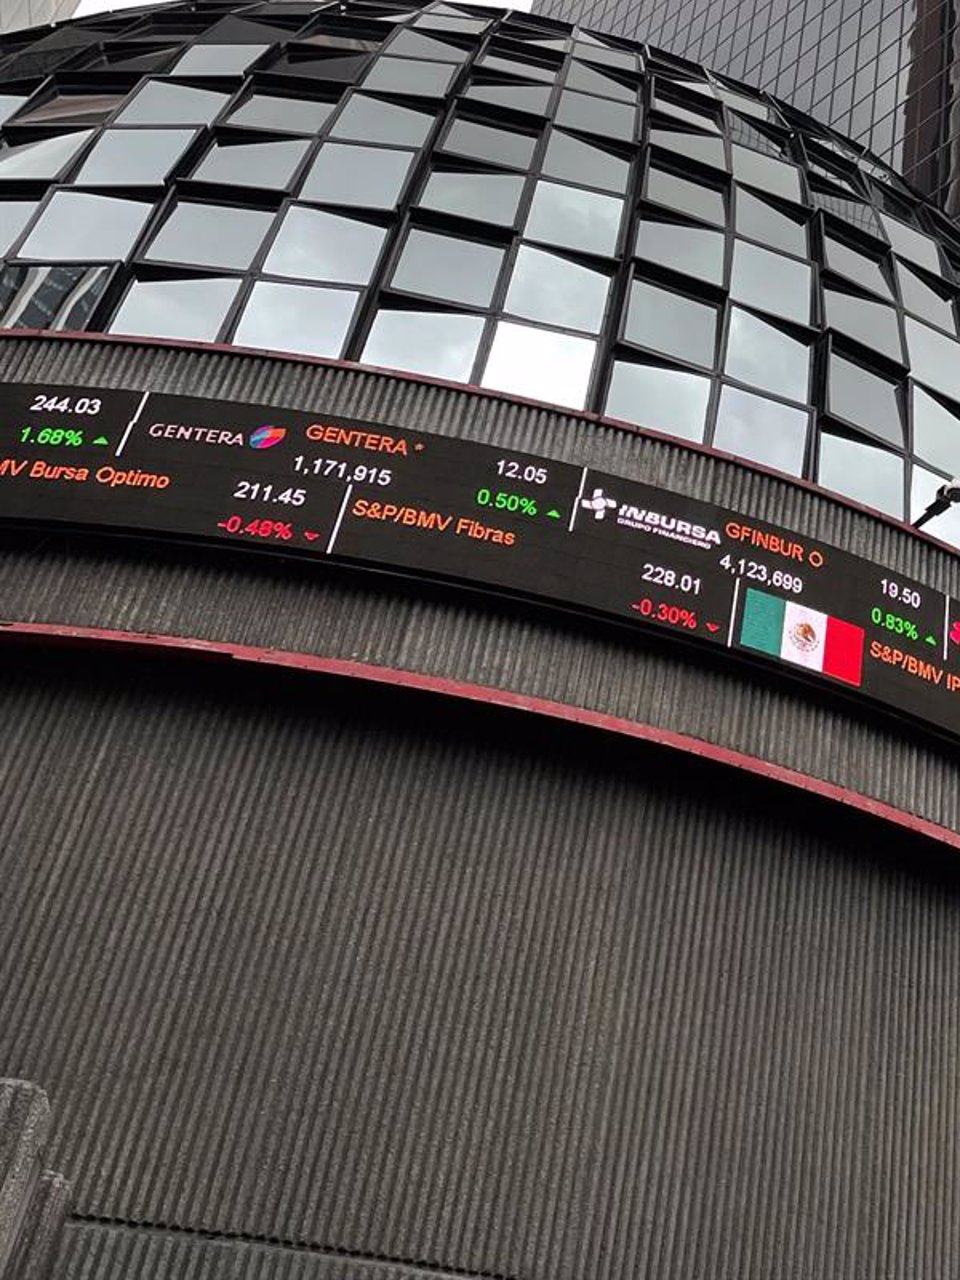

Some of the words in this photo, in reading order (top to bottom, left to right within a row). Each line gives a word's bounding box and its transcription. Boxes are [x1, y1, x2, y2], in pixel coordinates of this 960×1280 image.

[29, 394, 102, 415] 244.03
[19, 426, 84, 447] 1.68%
[148, 423, 244, 446] GENTERA
[305, 423, 408, 456] GENTERA
[29, 460, 88, 482] Bursa
[94, 466, 171, 490] Optimo
[292, 454, 392, 487] 1,171,915
[496, 459, 548, 485] 12.05
[233, 481, 307, 507] 211.45
[476, 488, 538, 517] 0.50%
[216, 515, 294, 541] -0.48%
[352, 499, 453, 532] S&P/BMV
[455, 519, 517, 546] Fibras
[616, 517, 652, 533] GRUPO
[618, 503, 721, 545] INBURSA
[725, 521, 804, 562] GFINBUR
[641, 563, 701, 596] 228.01
[719, 553, 804, 594] 4,123,699
[880, 577, 922, 609] 19.50
[631, 597, 698, 630] -0.30%
[871, 606, 919, 641] 0.83%
[869, 640, 944, 684] S&P/BMV
